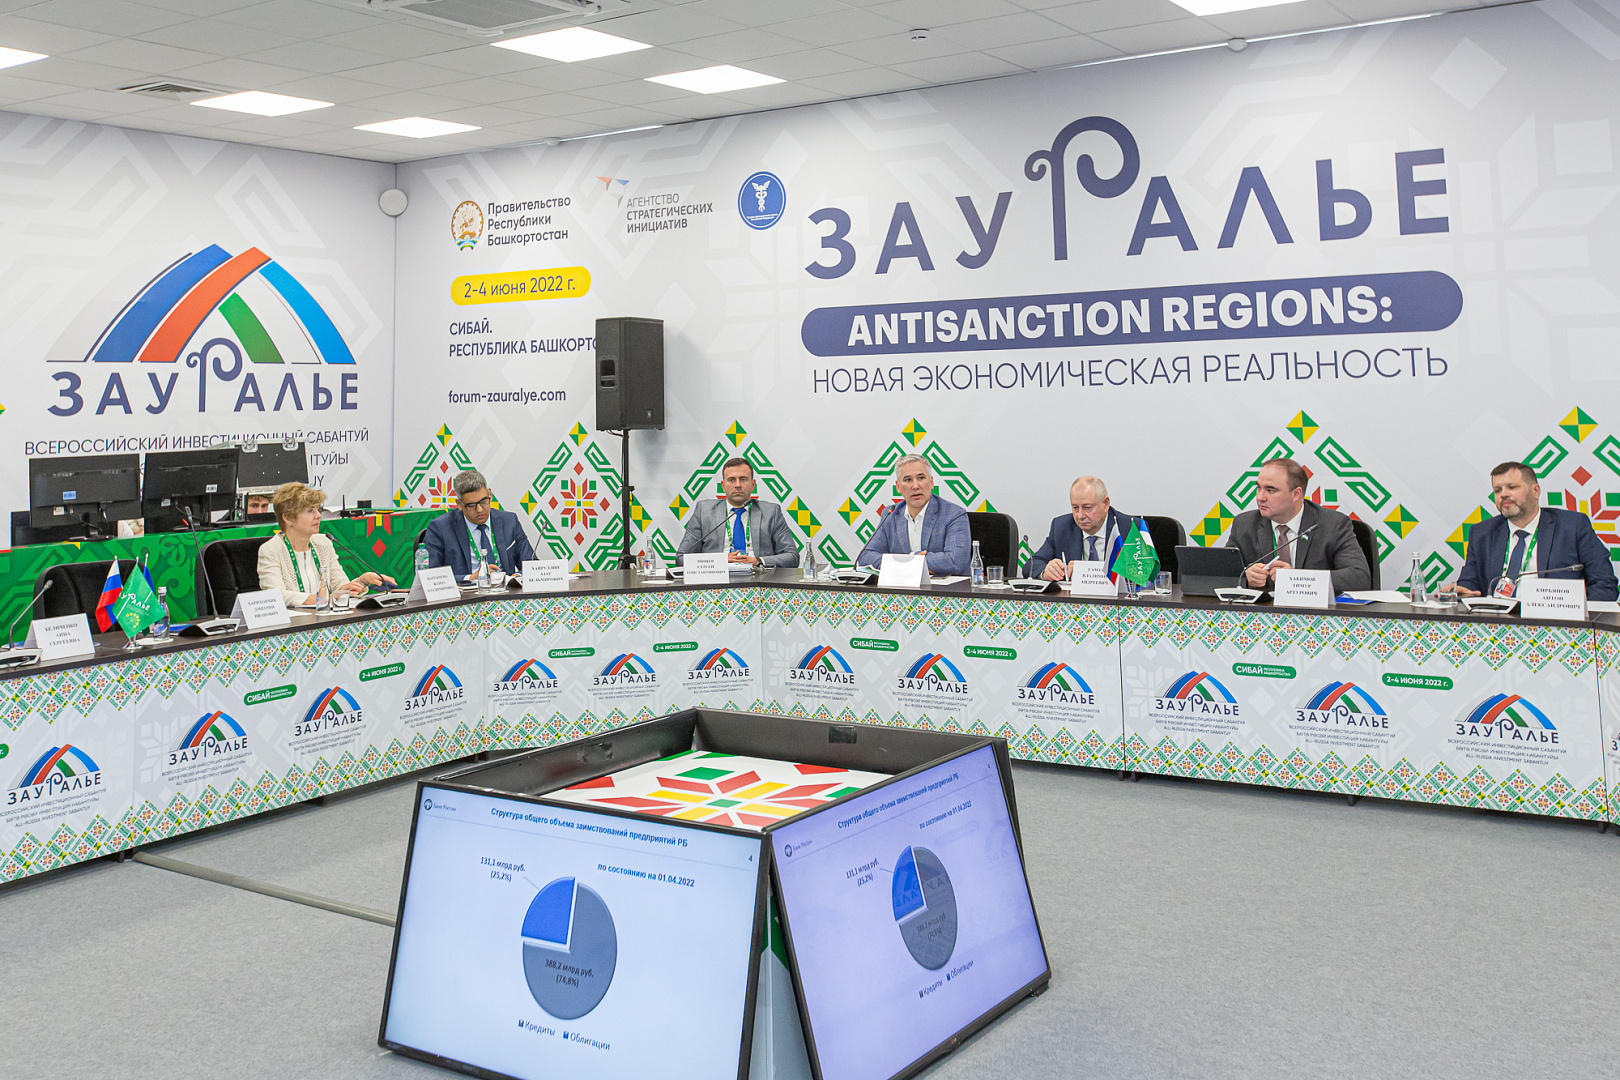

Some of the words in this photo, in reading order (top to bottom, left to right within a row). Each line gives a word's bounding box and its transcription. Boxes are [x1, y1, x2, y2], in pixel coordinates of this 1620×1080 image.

[487, 197, 571, 217] Правительство
[627, 193, 680, 208] АГЕНТСТВО
[805, 116, 1450, 280] ЗАУРАЛЬЕ
[627, 202, 713, 220] СТРАТЕГИЧЕСКИХ
[487, 215, 552, 231] Республики
[627, 218, 688, 233] ИНИЦИАТИВ
[487, 230, 569, 246] Башкортостан
[491, 282, 526, 296] июня
[530, 275, 563, 293] 2022
[567, 278, 576, 291] г.
[847, 296, 1151, 347] ANTISANCTION
[1162, 285, 1393, 332] REGIONS:
[449, 317, 493, 336] СИБАЙ.
[449, 340, 527, 357] РЕСПУБЛИКА
[47, 337, 358, 417] ЗАУРАЛЬЕ
[813, 366, 904, 394] НОВАЯ
[913, 355, 1191, 391] ЭКОНОМИЧЕСКАЯ
[1203, 347, 1449, 384] РЕАЛЬНОСТЬ
[448, 388, 566, 405] forum-zauralye.com
[24, 434, 169, 456] ВСЕРОССИЙСКИЙ
[307, 427, 369, 444] САБАНТУЙ
[853, 640, 874, 648] СИБАЙ
[593, 669, 656, 685] ЗАУРАЛЬЕ
[688, 664, 750, 680] ЗАУРАЛЬЕ
[790, 665, 855, 684] ЗАУРАЛЬЕ
[1236, 665, 1263, 674] СИБАЙ
[493, 675, 558, 692] ЗАУРАЛЬЕ
[898, 673, 968, 694] ЗАУРАЛЬЕ
[1400, 677, 1424, 685] ИЮНЯ
[1424, 678, 1442, 686] 2022
[247, 690, 270, 703] СИБАЙ
[405, 687, 464, 711] ЗАУРАЛЬЕ
[1018, 683, 1095, 705] ЗАУРАЛЬЕ
[1155, 693, 1239, 716] ЗАУРАЛЬЕ
[295, 710, 362, 737] ЗАУРАЛЬЕ
[1296, 705, 1389, 729] ЗАУРАЛЬЕ
[1455, 718, 1559, 744] ЗАУРАЛЬЕ
[169, 736, 248, 766] ЗАУРАЛЬЕ
[7, 772, 101, 805] ЗАУРАЛЬЕ
[491, 807, 523, 821] Структура
[525, 813, 548, 824] общего
[549, 817, 575, 829] объема
[576, 823, 628, 838] заимствований
[629, 831, 676, 846] предприятий
[677, 838, 688, 848] РБ
[838, 814, 862, 829] Структура
[480, 856, 496, 867] 131,1
[496, 861, 512, 871] млрд
[513, 863, 526, 873] руб.
[490, 870, 512, 883] (25,2%)
[598, 863, 607, 871] по
[608, 864, 647, 879] состоянию
[658, 873, 695, 888] 01.04.2022
[562, 964, 579, 976] млрд
[580, 968, 594, 978] руб.
[556, 974, 579, 989] (74,8%)
[525, 1020, 556, 1036] Кредиты
[570, 1032, 611, 1051] Облигации
